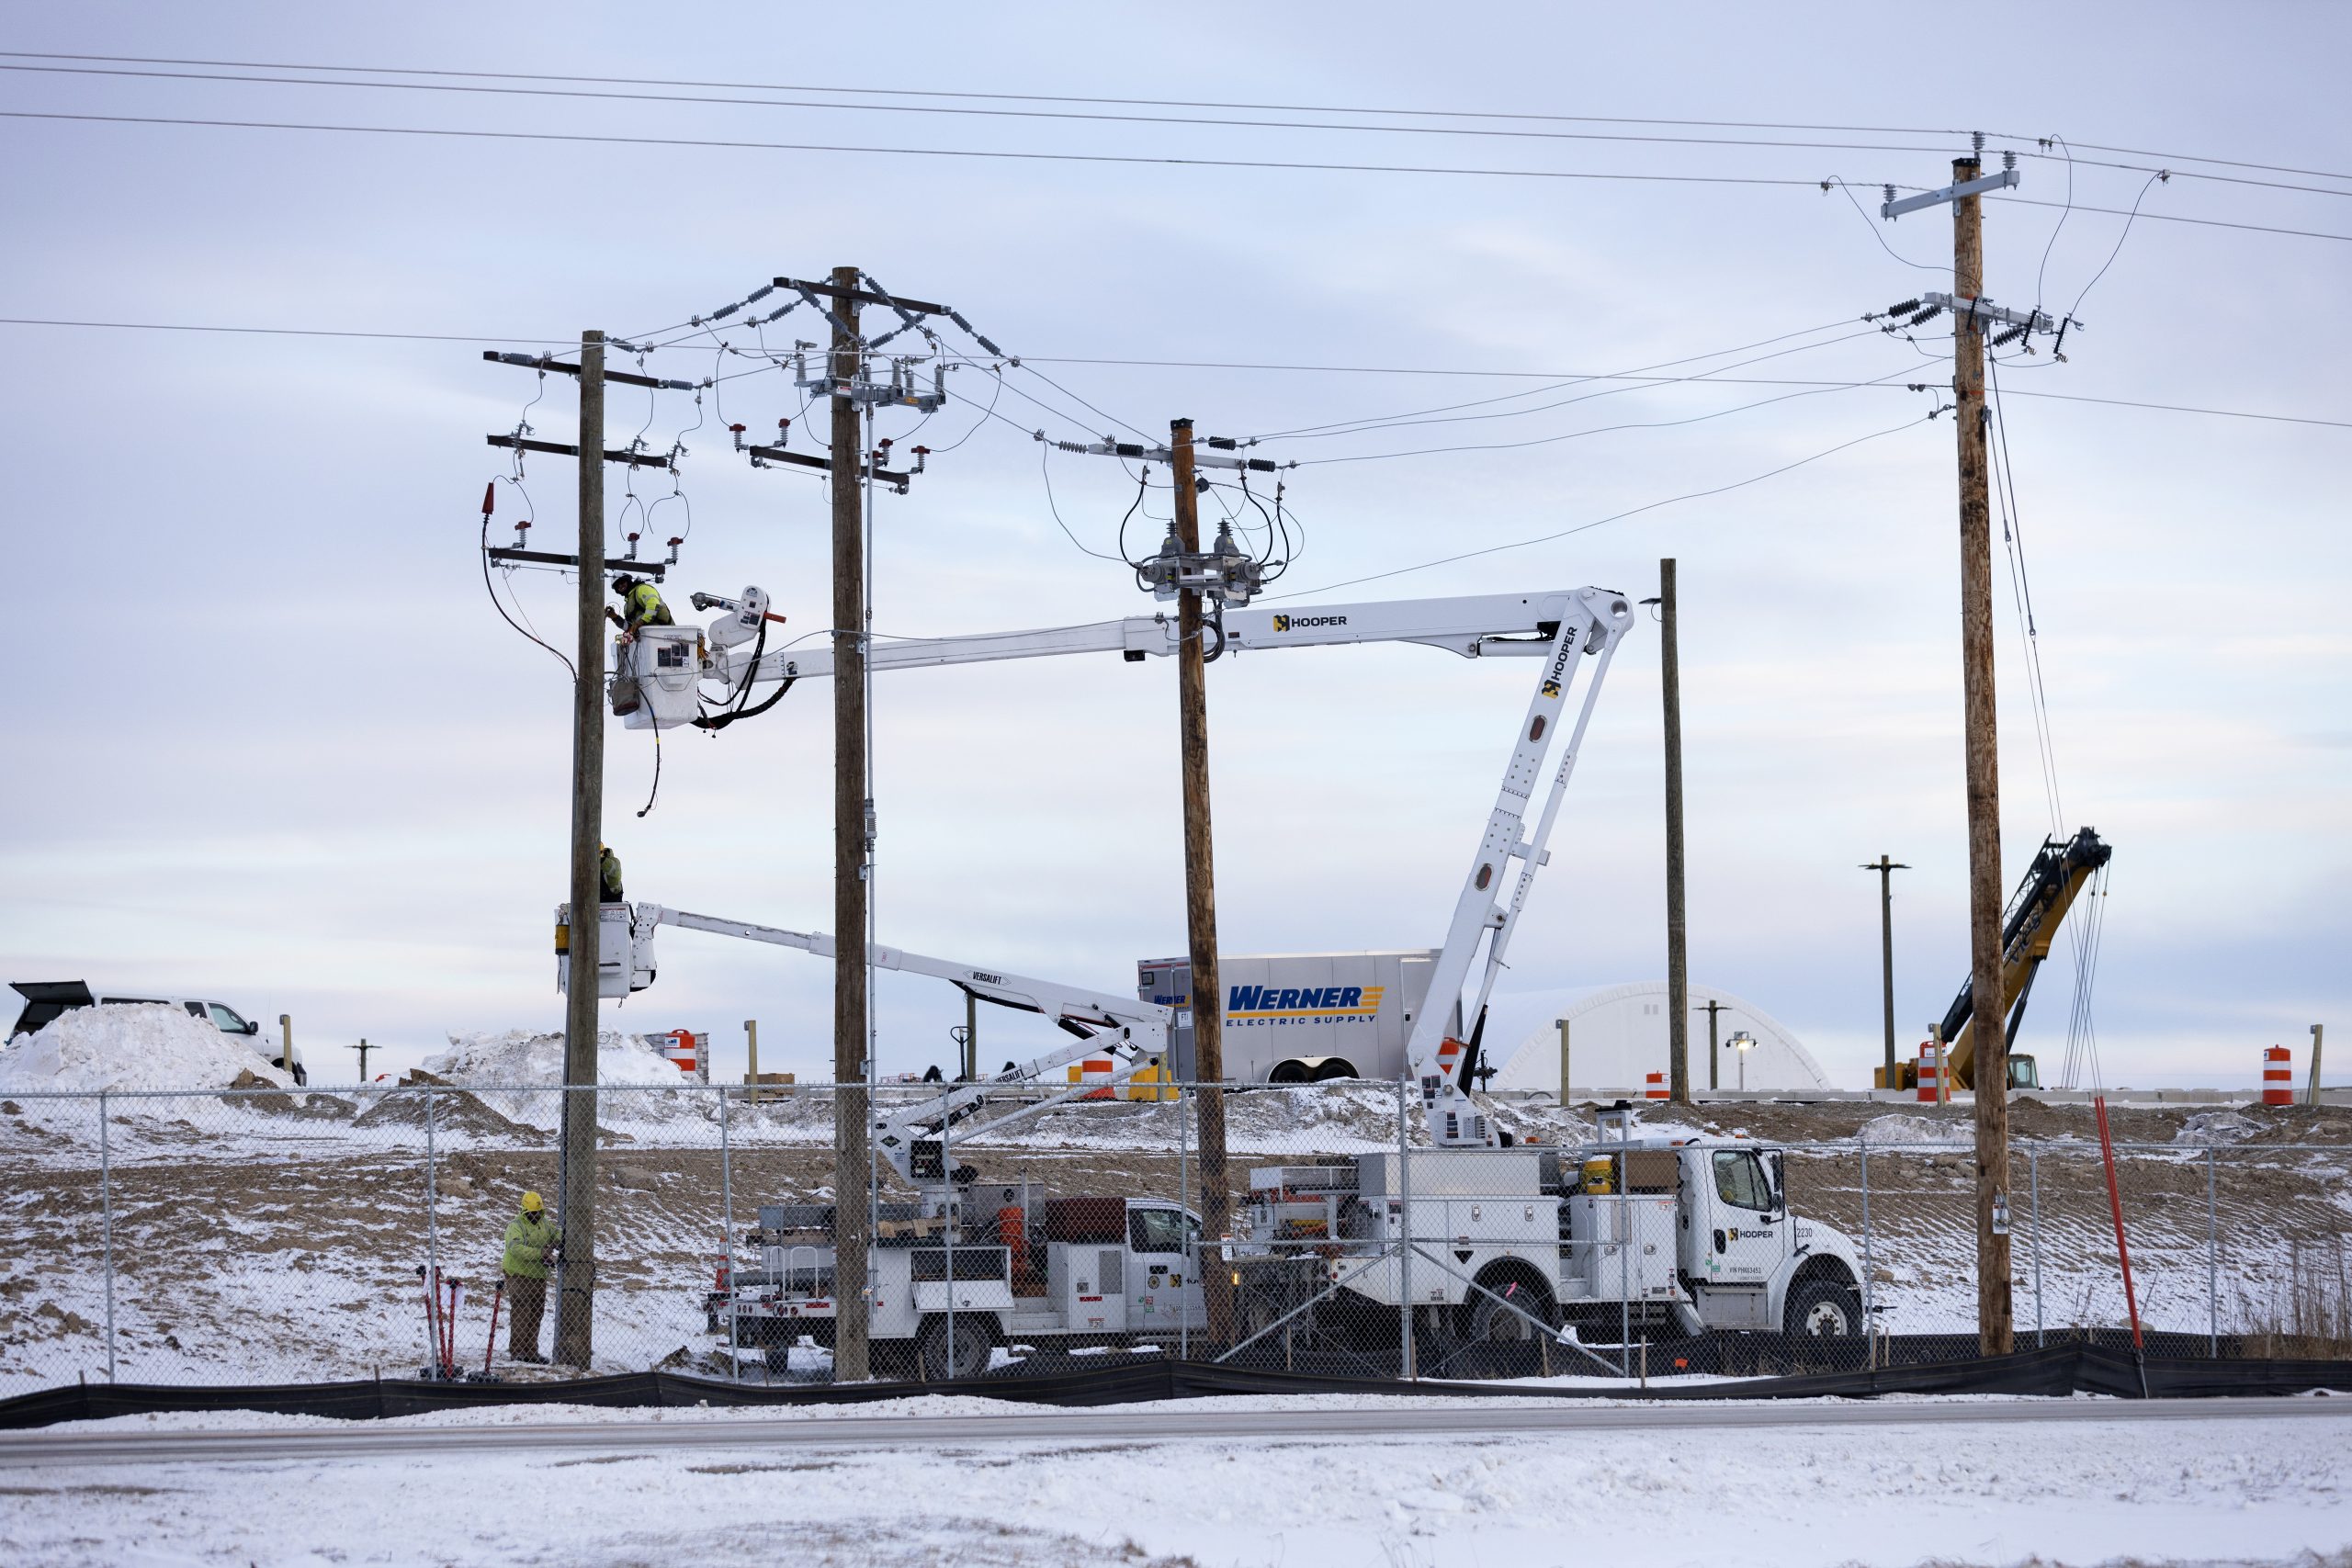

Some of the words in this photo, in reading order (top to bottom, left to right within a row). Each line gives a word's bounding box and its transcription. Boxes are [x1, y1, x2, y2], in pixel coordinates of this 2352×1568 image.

[1291, 615, 1348, 627] HOOPER
[1551, 626, 1578, 681] HOOPER
[972, 971, 1002, 985] VERSALIFT
[1228, 985, 1363, 1011] WERNER
[1226, 1017, 1306, 1027] ELECTRIC
[1314, 1015, 1376, 1025] SUPPLY
[1740, 1230, 1773, 1238] HOOPER
[1796, 1227, 1813, 1237] 2230
